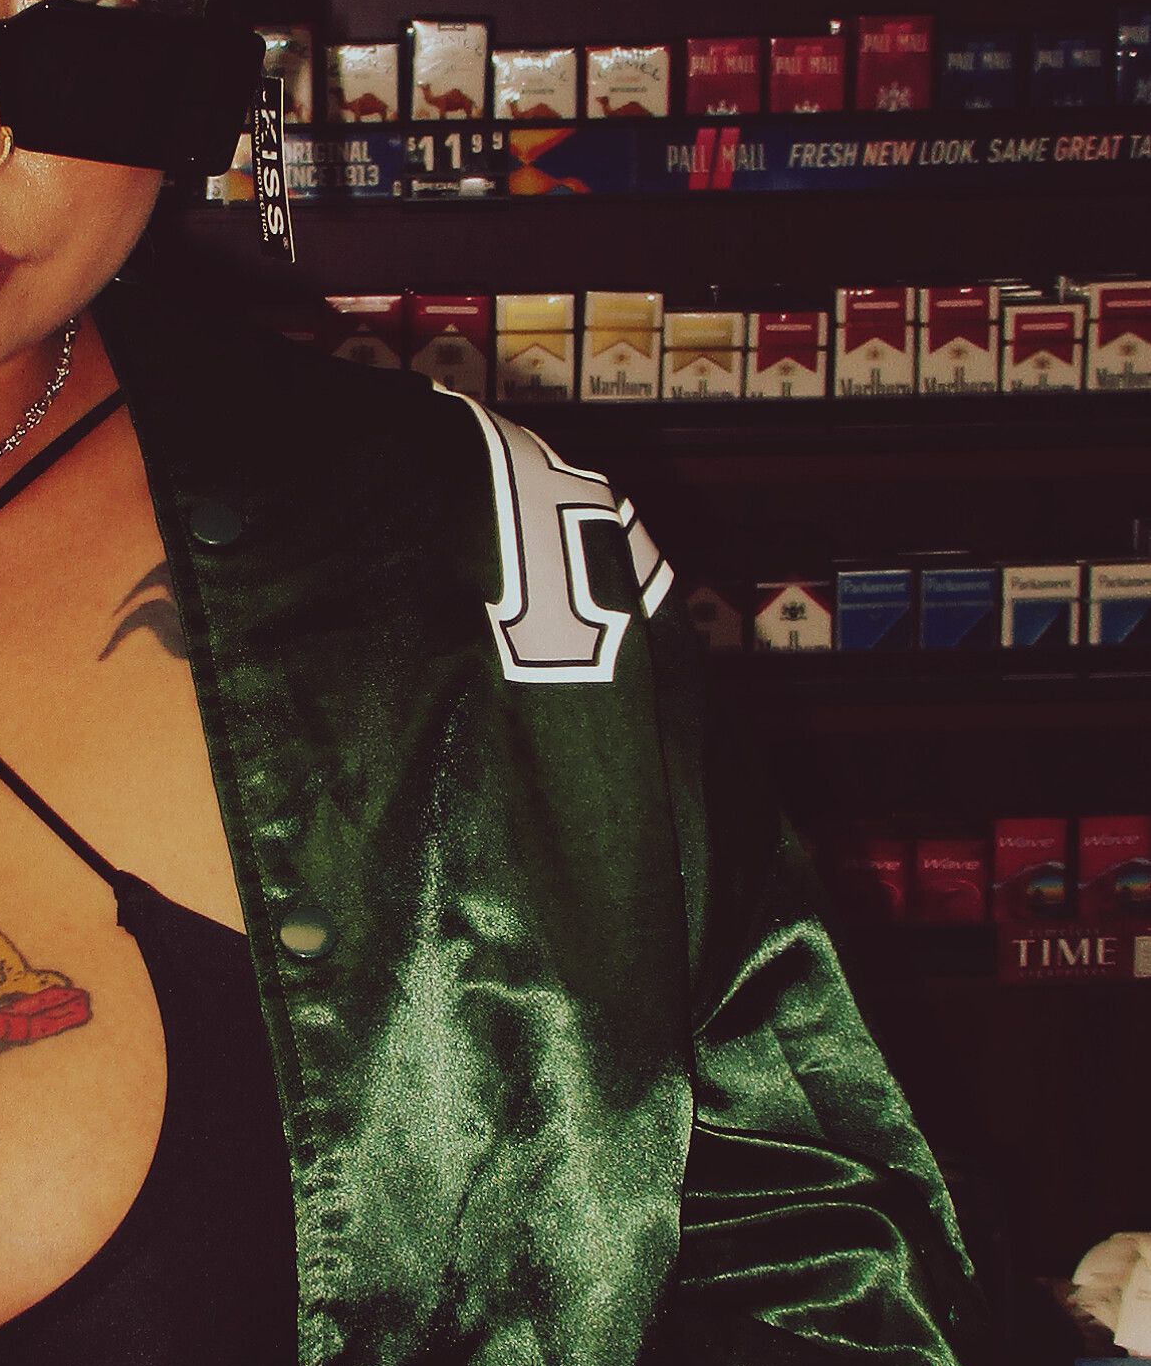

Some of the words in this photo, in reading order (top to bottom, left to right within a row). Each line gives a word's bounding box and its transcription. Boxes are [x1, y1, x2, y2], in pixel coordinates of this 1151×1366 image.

[666, 144, 709, 173] PALL
[720, 140, 767, 172] MALL
[787, 140, 858, 169] FRESH
[861, 139, 917, 167] NEW
[917, 138, 980, 167] LOOK.
[987, 137, 1050, 164] SAME
[1054, 135, 1124, 163] GREAT
[260, 108, 285, 235] KISS
[255, 156, 270, 242] PROTECTION
[590, 371, 652, 397] Marlboro
[1011, 937, 1119, 968] TIME
